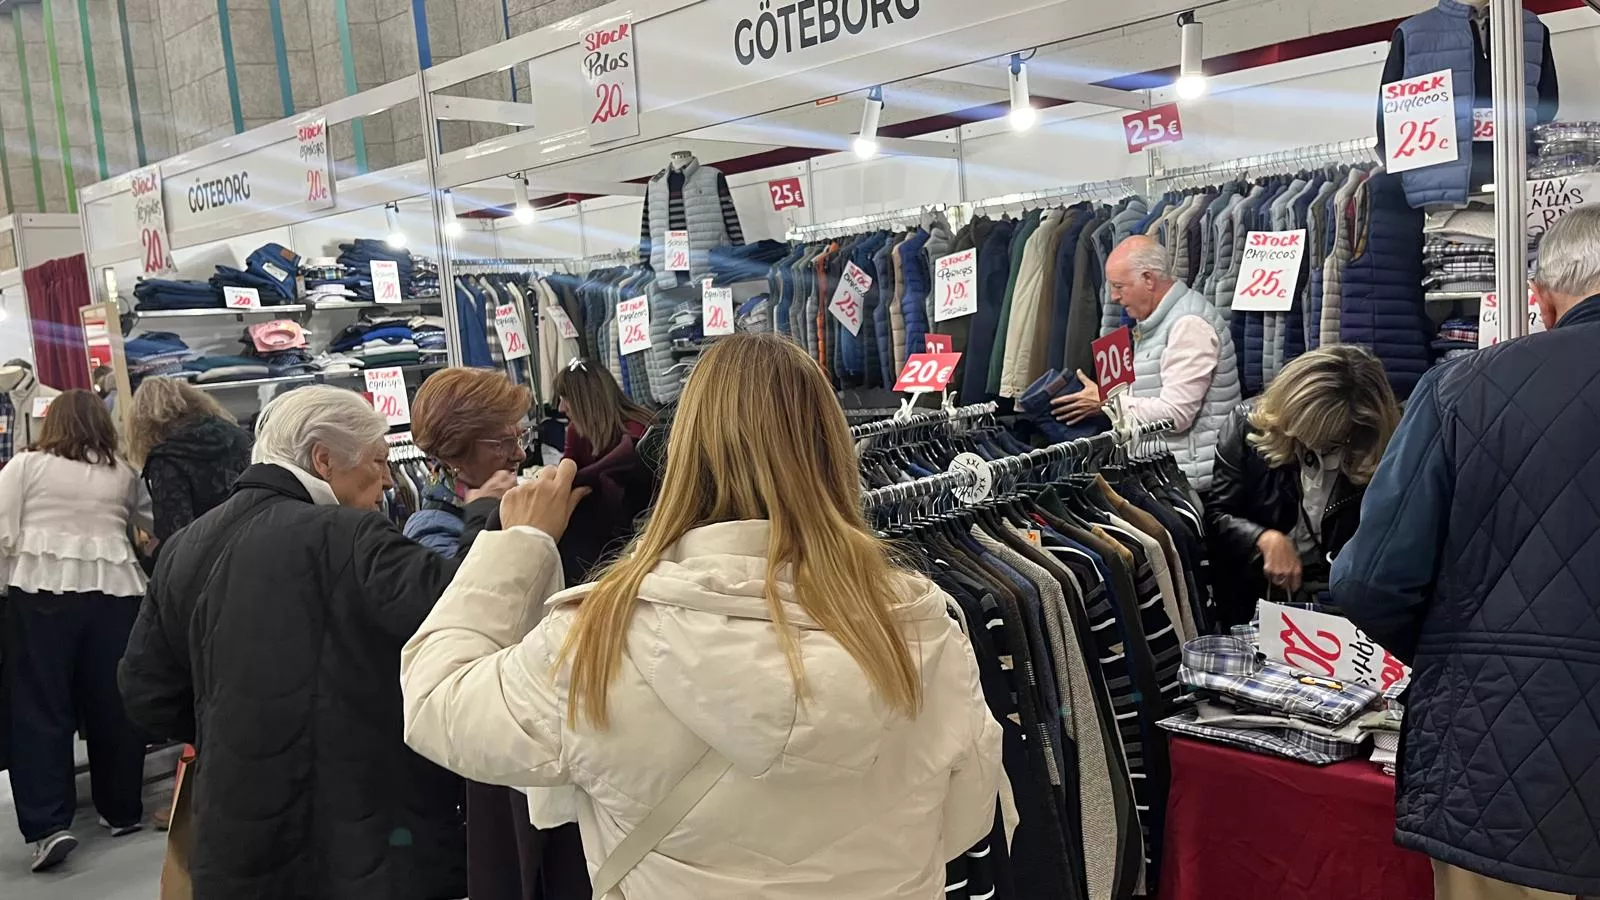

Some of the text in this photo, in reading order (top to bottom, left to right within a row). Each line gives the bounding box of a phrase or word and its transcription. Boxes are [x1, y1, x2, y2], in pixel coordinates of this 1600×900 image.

[584, 24, 629, 51] STOCK
[1385, 76, 1445, 99] STOCK
[298, 123, 324, 142] STOCK
[1127, 114, 1180, 146] 25€
[131, 172, 158, 197] STOCK
[188, 171, 251, 213] GÖTEBORG
[771, 184, 802, 206] 25€
[1532, 178, 1568, 197] HAY
[1249, 233, 1300, 247] STOCK
[941, 252, 972, 268] STOCK
[900, 360, 952, 383] 20€
[1096, 344, 1132, 387] 20€
[965, 457, 980, 470] XXL
